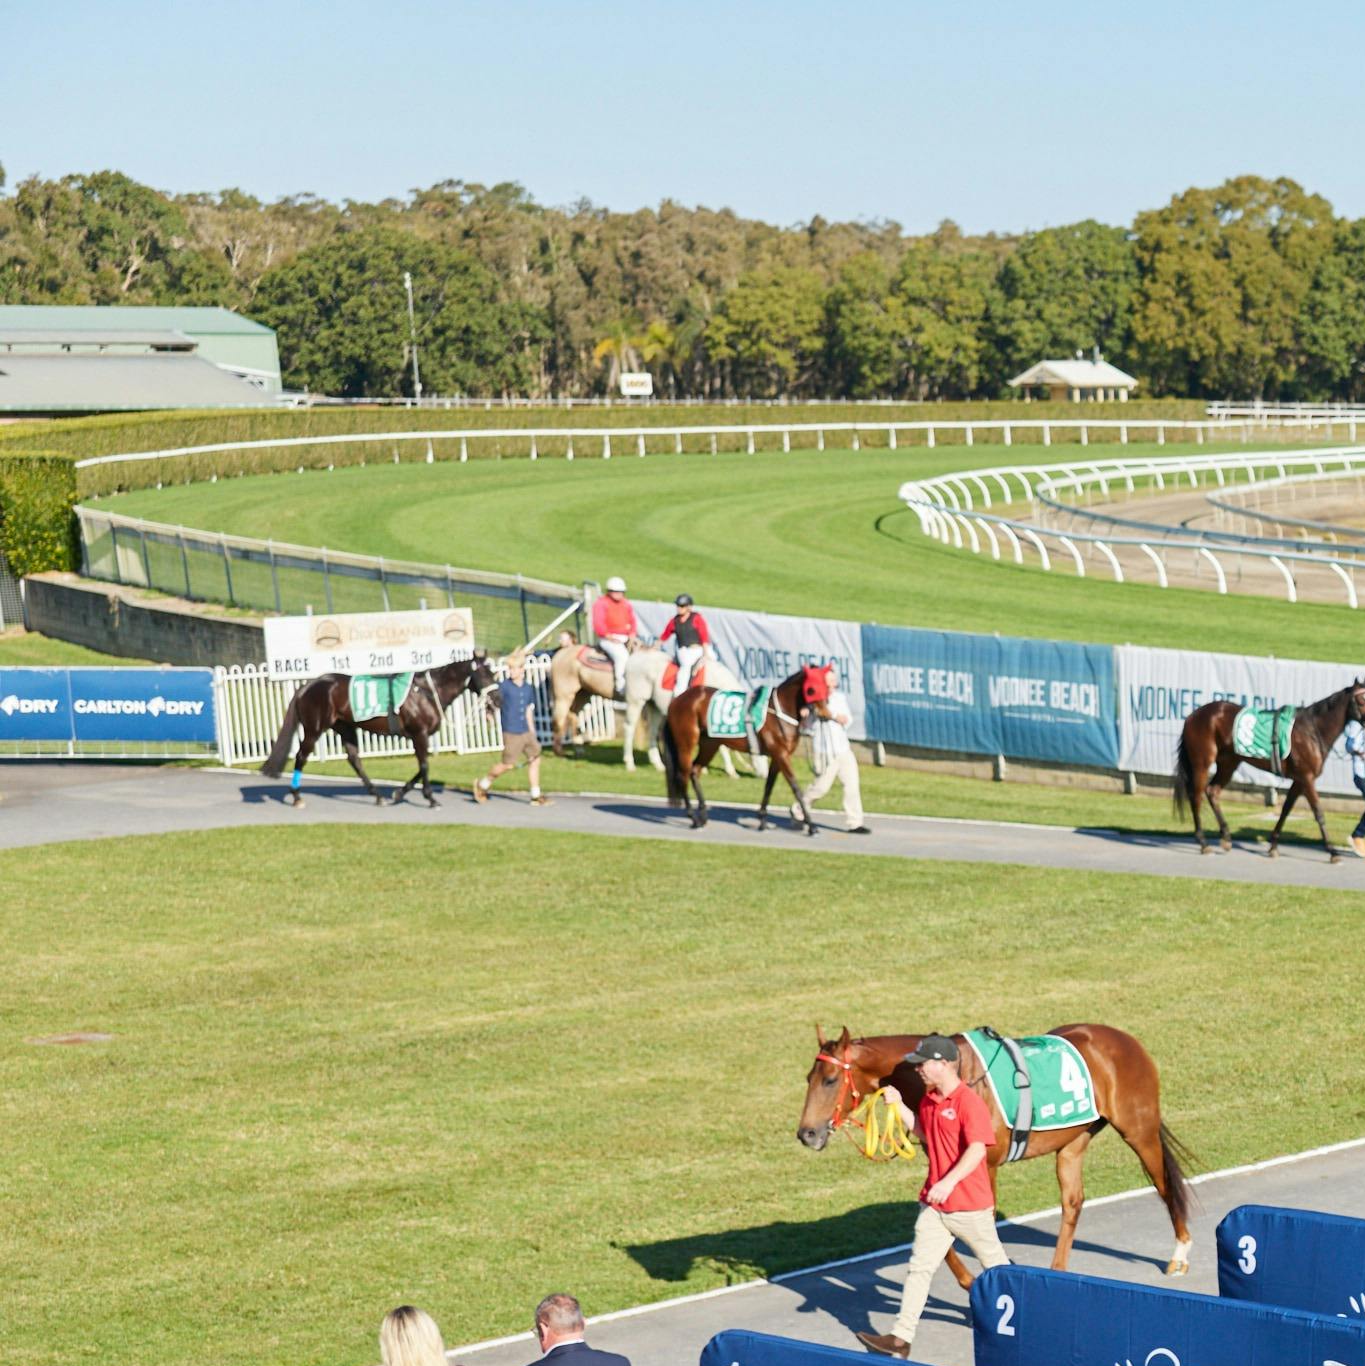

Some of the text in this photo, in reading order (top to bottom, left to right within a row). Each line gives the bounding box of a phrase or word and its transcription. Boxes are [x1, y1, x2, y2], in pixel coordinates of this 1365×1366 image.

[275, 648, 471, 673] RACE 1st 2nd 3rd 4th
[353, 680, 378, 710] 11
[872, 663, 925, 695] MOONEE
[928, 668, 974, 706] BEACH
[989, 675, 1100, 718] MOONEE BEACH
[19, 699, 59, 714] DRY
[74, 699, 204, 715] CARLTON DRY
[1059, 1051, 1088, 1101] 4
[1237, 1235, 1257, 1275] 3
[996, 1294, 1016, 1337] 2
